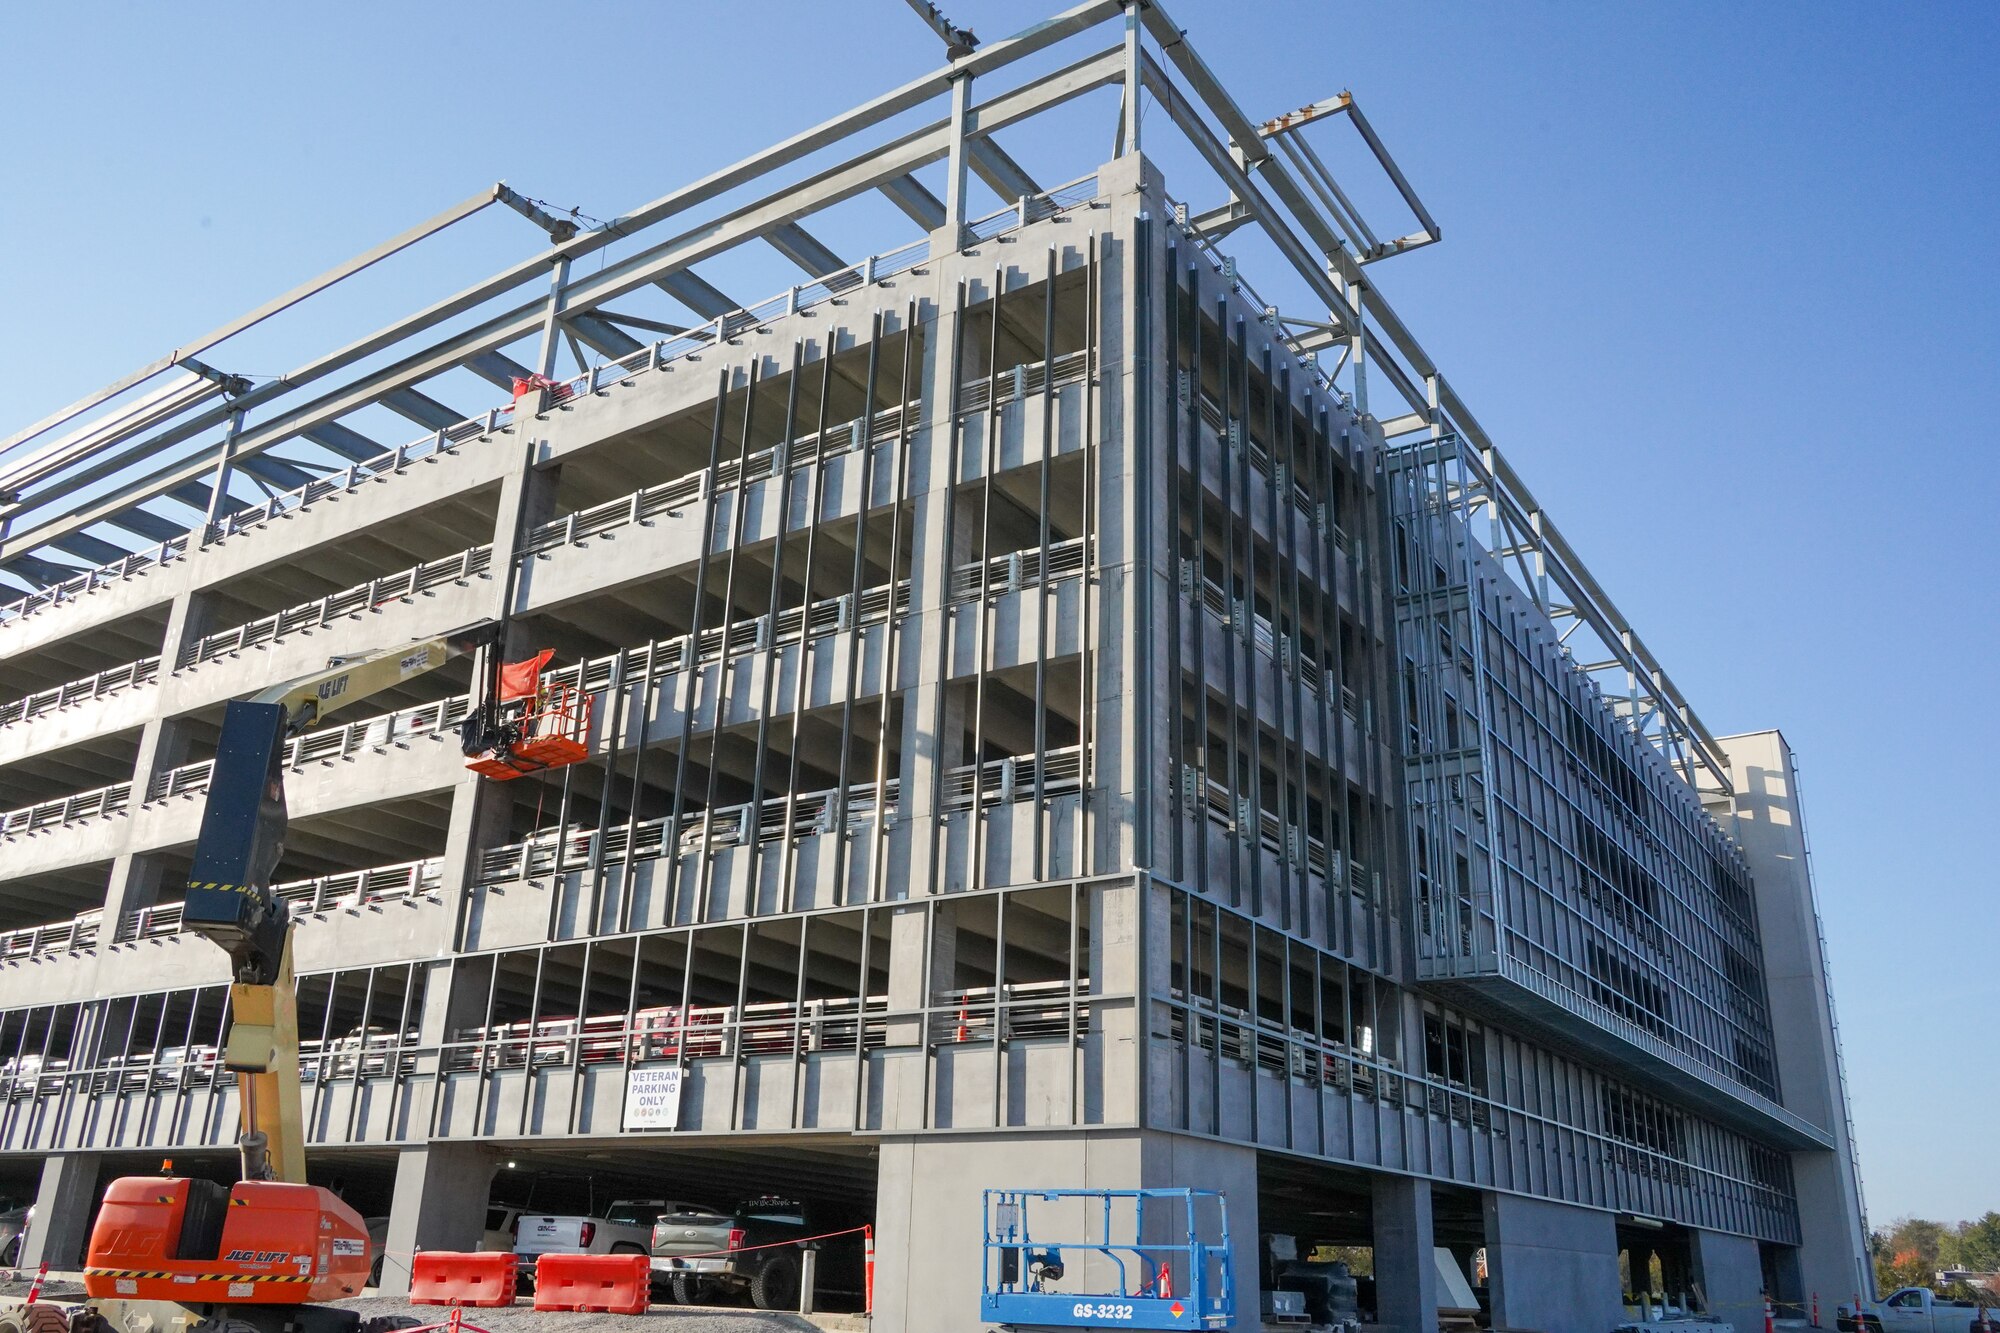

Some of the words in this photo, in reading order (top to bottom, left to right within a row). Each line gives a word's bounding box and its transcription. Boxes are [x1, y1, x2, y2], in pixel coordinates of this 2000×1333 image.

[331, 675, 349, 697] LIFT
[633, 1071, 679, 1082] VETERAN
[632, 1083, 676, 1094] PARKING
[639, 1096, 666, 1106] ONLY
[95, 1229, 162, 1256] JLG
[224, 1249, 256, 1261] JLG
[254, 1251, 290, 1263] LIFT
[1073, 1303, 1133, 1320] GS-3232
